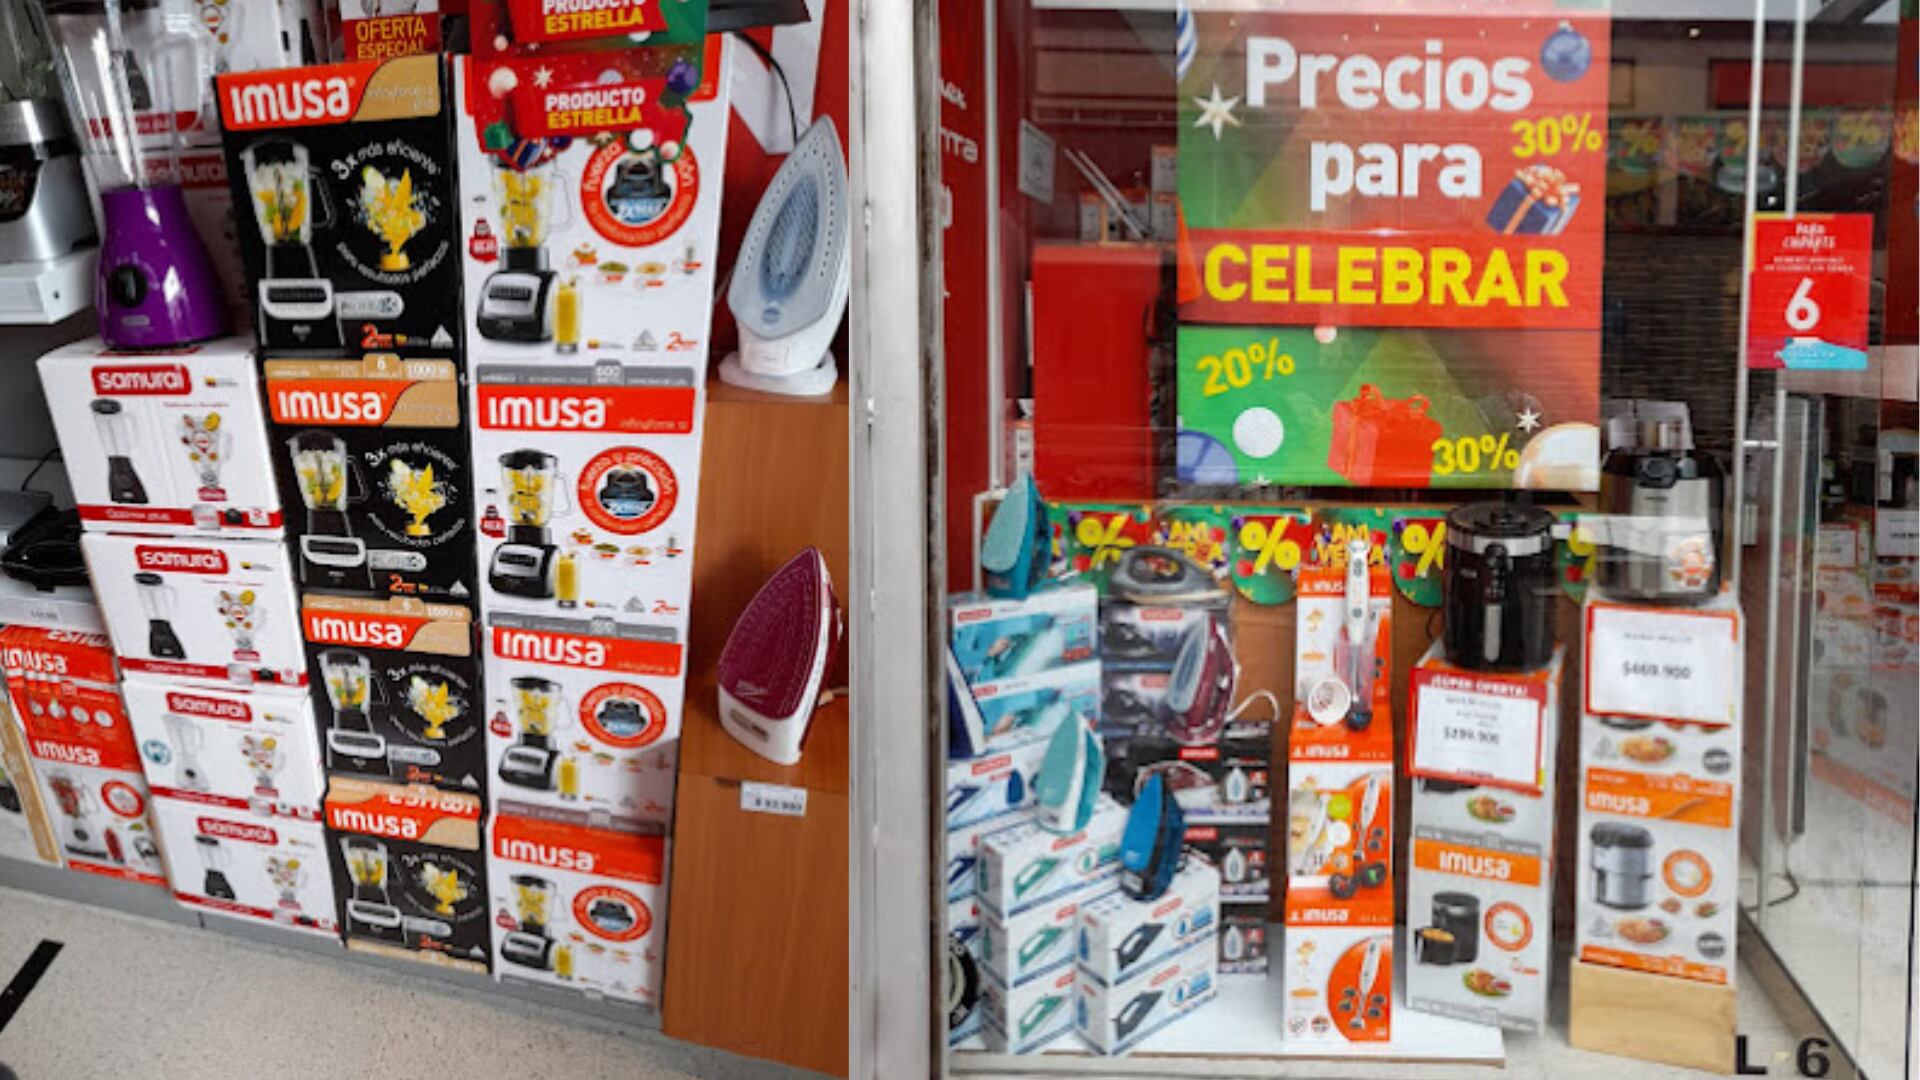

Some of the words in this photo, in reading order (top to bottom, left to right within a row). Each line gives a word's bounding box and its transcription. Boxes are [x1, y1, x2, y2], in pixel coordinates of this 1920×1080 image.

[355, 16, 429, 42] OFERTA
[545, 7, 644, 33] ESTRELLA
[357, 40, 428, 60] ESPECIAL
[1246, 36, 1533, 112] Precios
[545, 87, 646, 112] PRODUCTO
[547, 108, 643, 129] ESTRELLA
[1510, 112, 1602, 158] 30%
[1310, 140, 1483, 212] para
[1203, 243, 1570, 307] CELEBRAR
[1784, 276, 1821, 331] 6
[1196, 336, 1295, 397] 20%
[1431, 432, 1521, 476] 30%
[1796, 1037, 1831, 1079] 6
